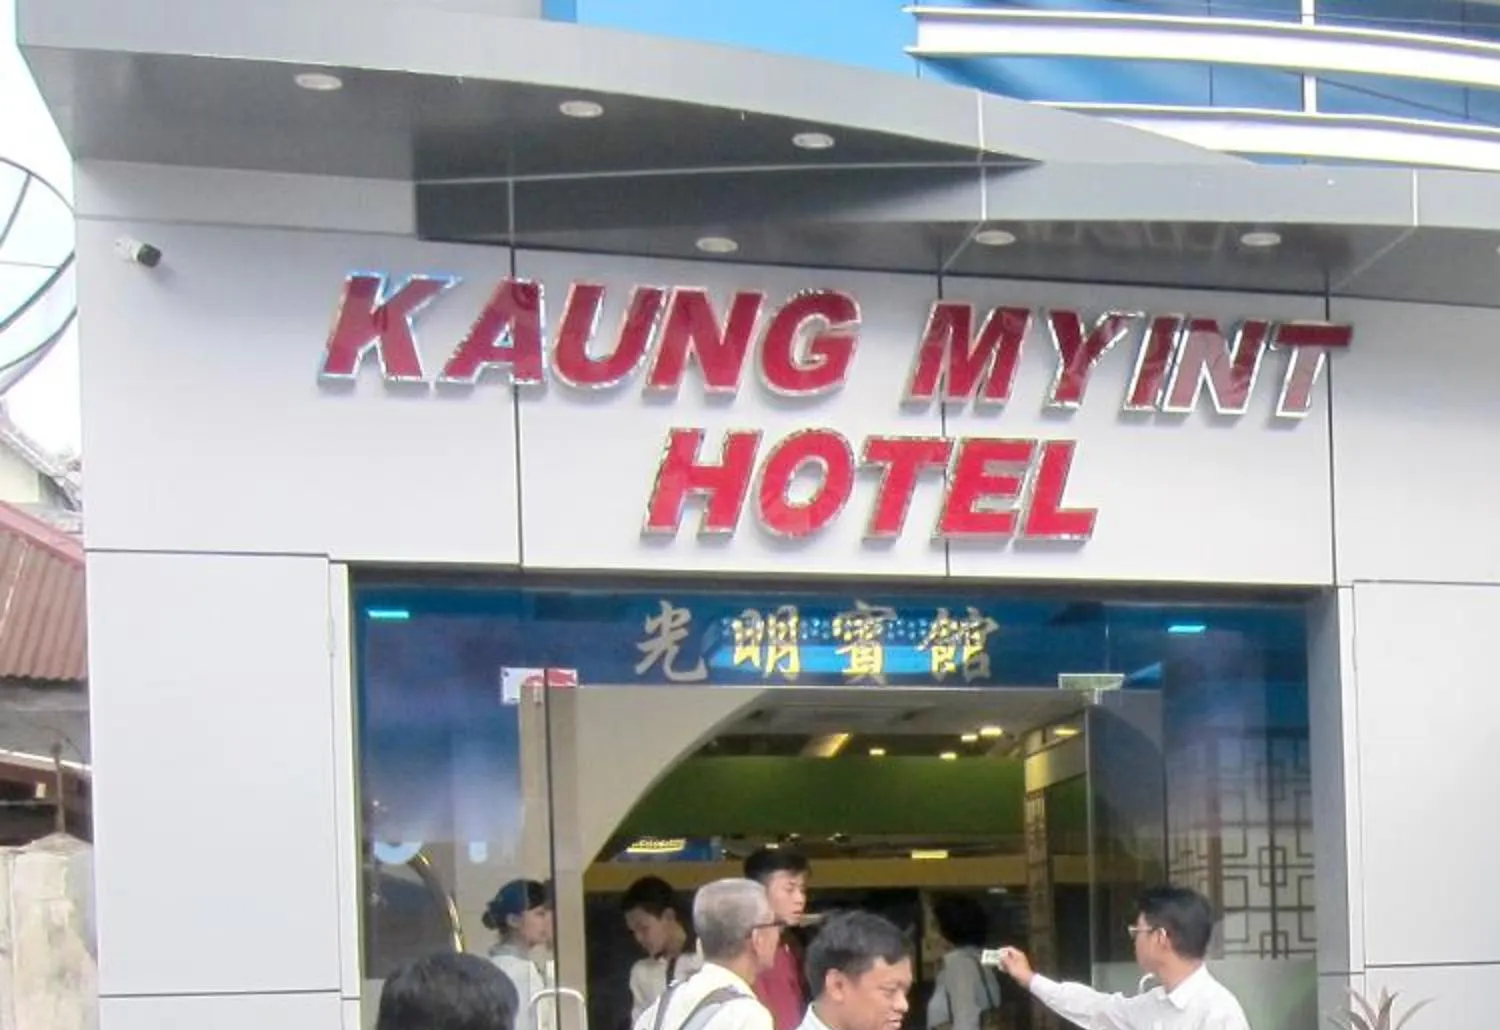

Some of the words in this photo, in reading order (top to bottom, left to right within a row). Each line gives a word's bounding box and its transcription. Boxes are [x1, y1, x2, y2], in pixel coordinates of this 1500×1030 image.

[319, 269, 860, 396] KAUNG
[910, 302, 1353, 419] MYINT
[640, 428, 1100, 541] HOTEL
